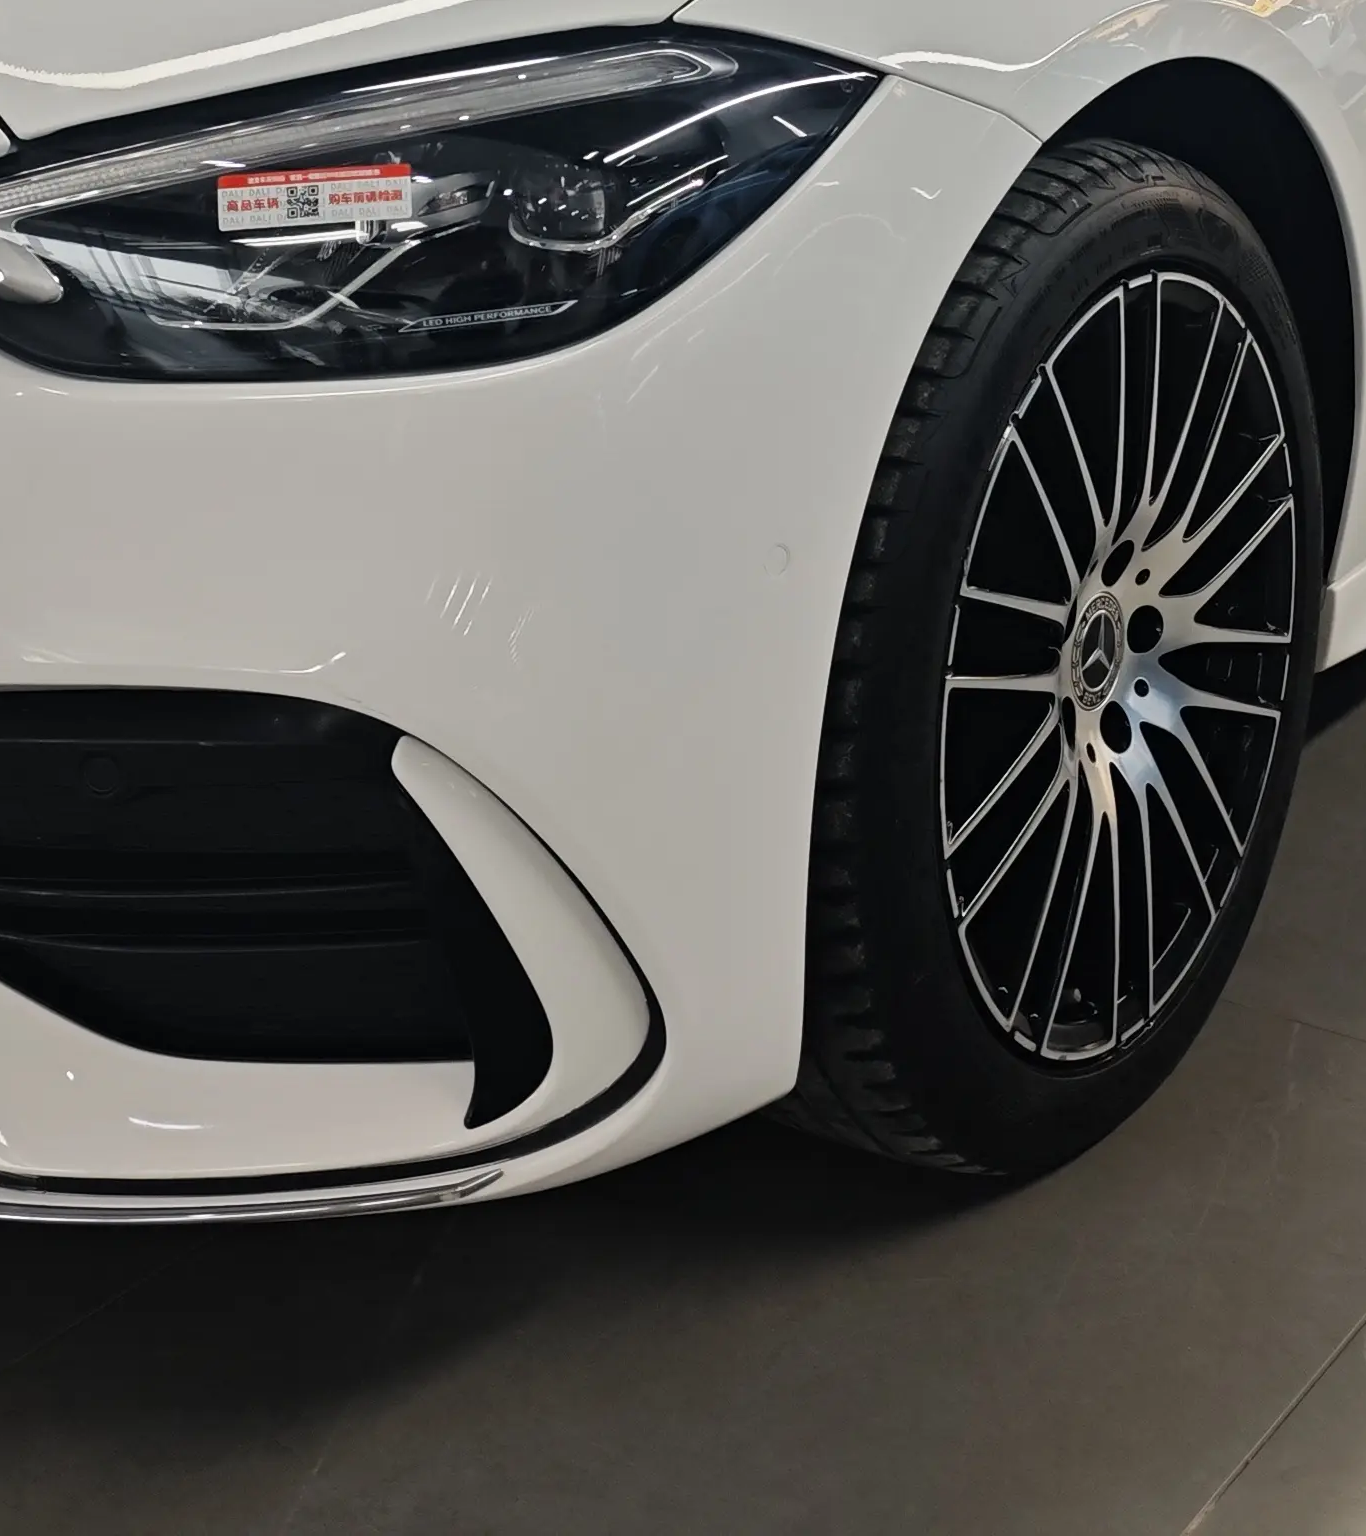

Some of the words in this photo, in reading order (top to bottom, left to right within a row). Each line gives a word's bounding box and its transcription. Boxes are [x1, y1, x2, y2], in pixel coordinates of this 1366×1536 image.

[422, 318, 443, 327] LED
[445, 314, 472, 325] HIGH
[473, 305, 552, 321] PERFORMANCE
